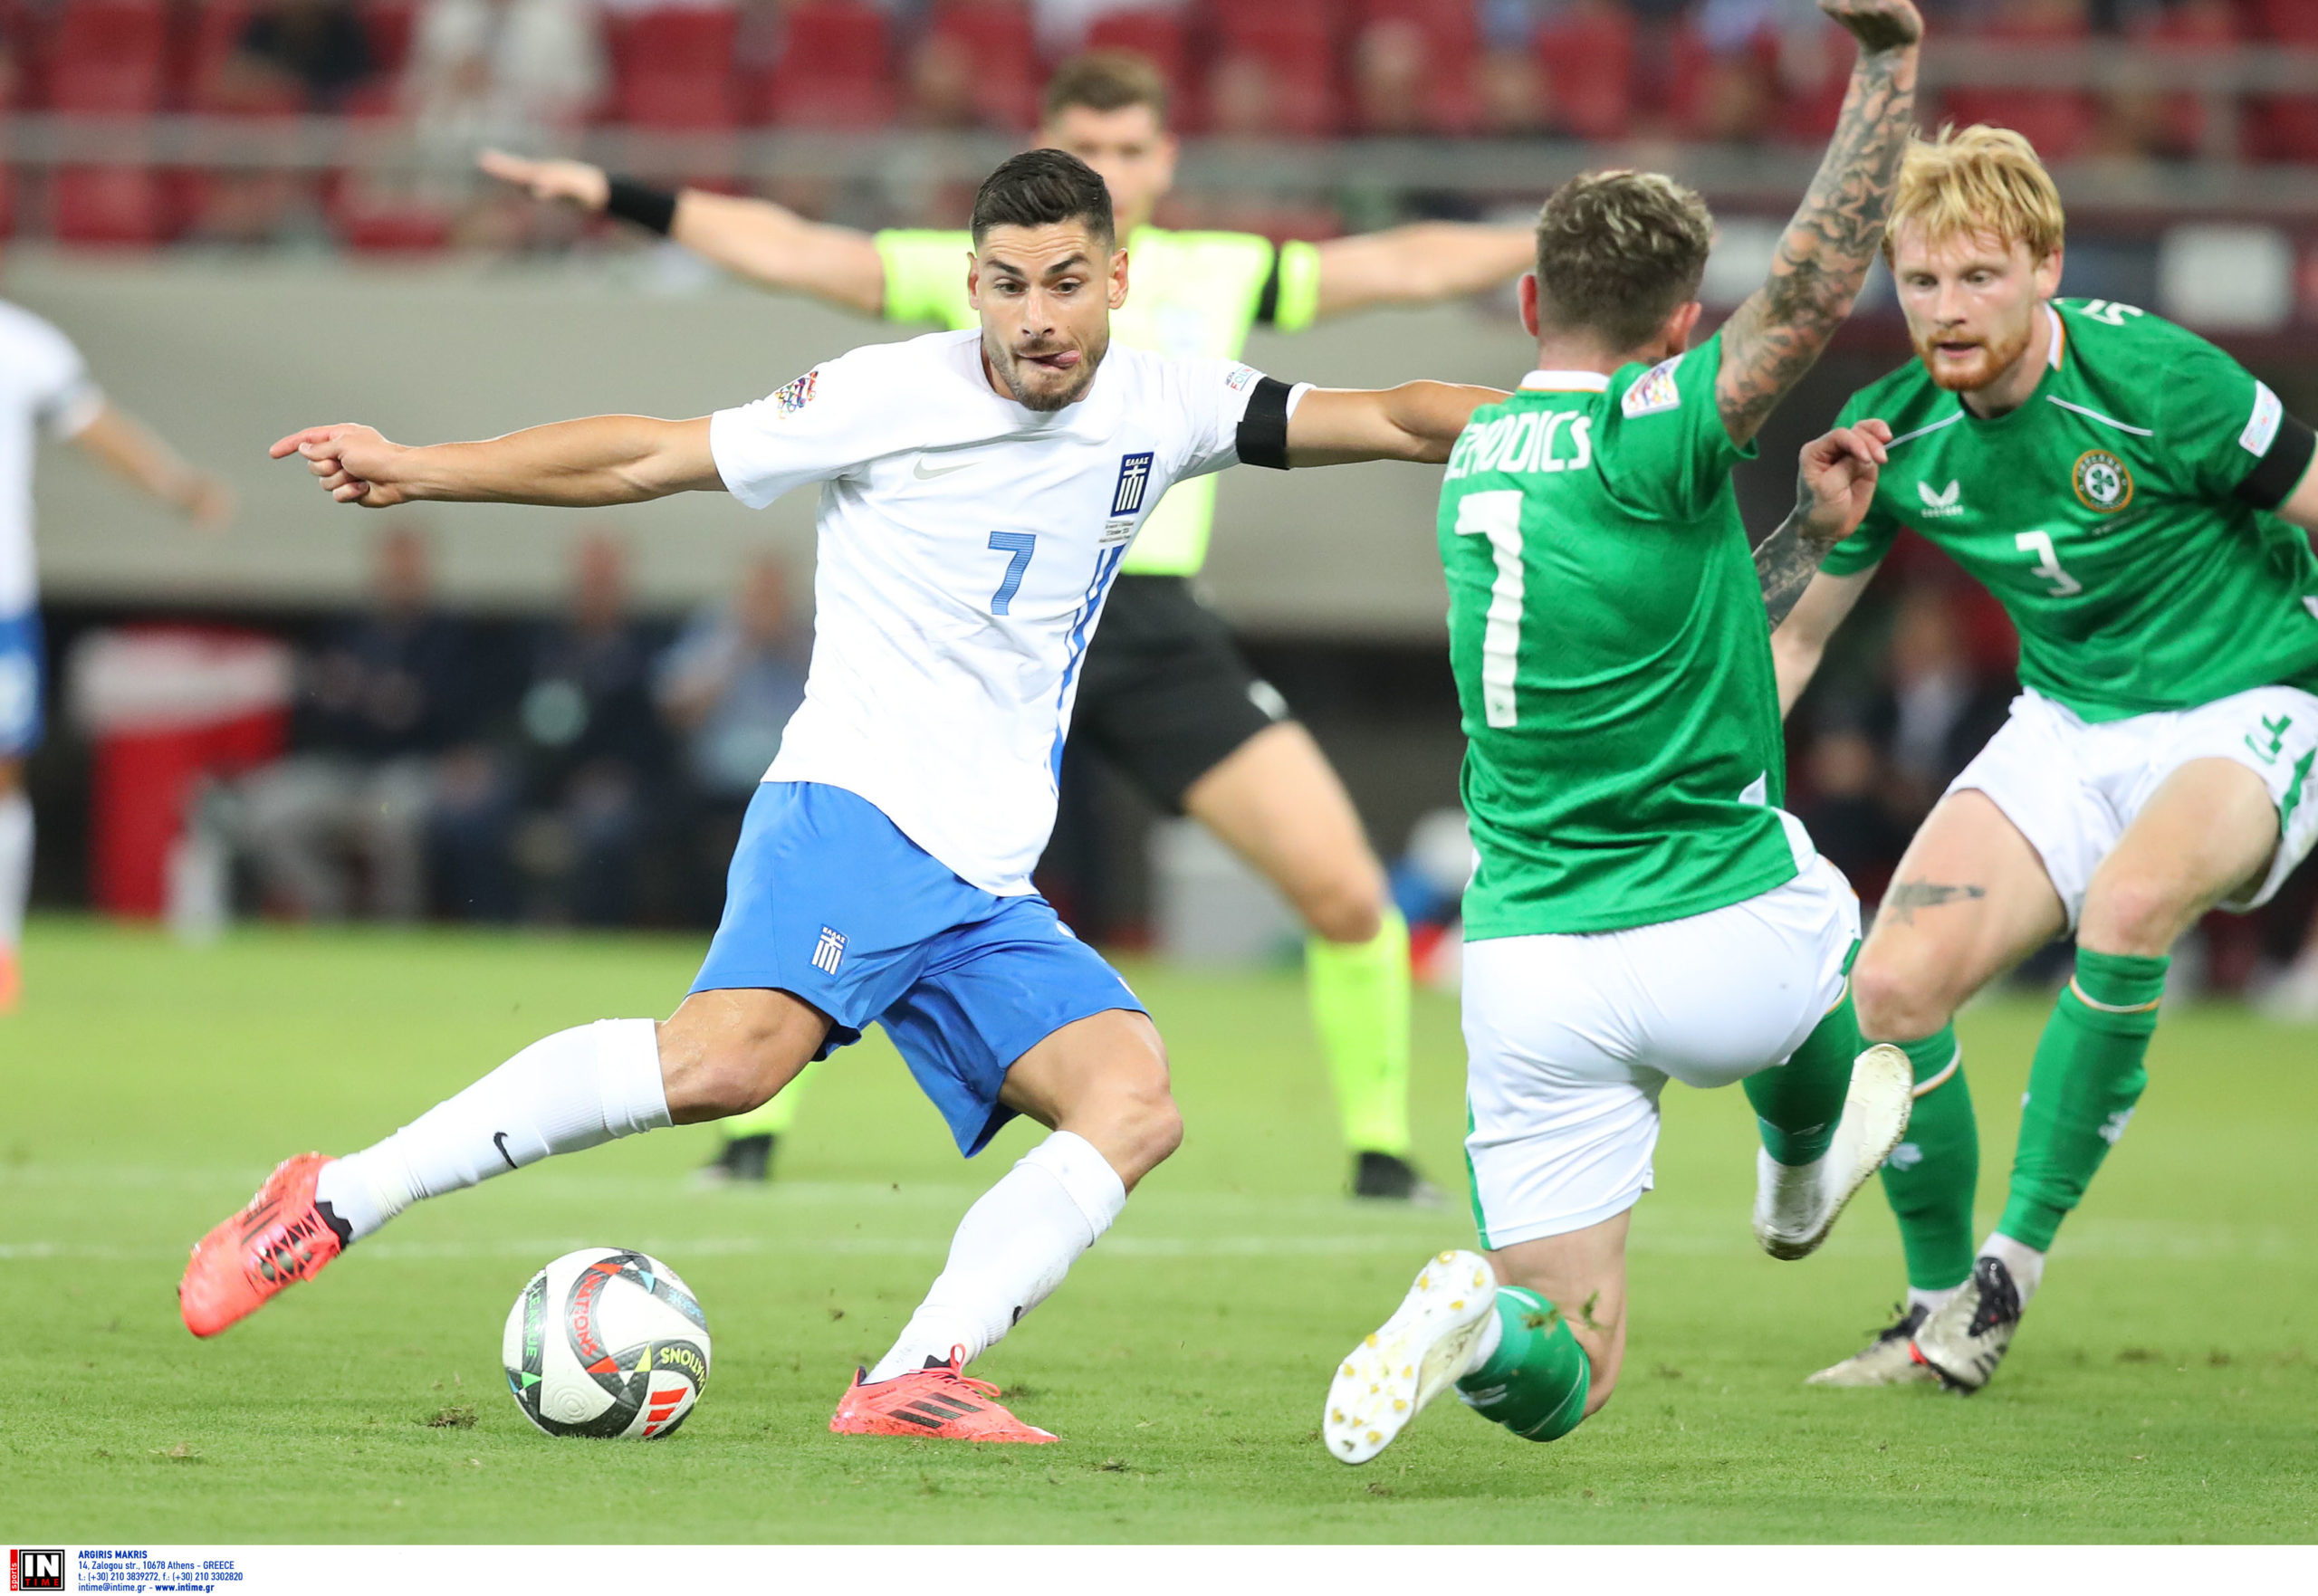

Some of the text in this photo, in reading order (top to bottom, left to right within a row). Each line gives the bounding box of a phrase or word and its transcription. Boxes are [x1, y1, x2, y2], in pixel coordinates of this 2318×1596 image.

[988, 530, 1036, 616] 7
[2016, 530, 2082, 597] 3
[526, 1287, 542, 1358] LEAGUE
[574, 1274, 602, 1356] NATIONS
